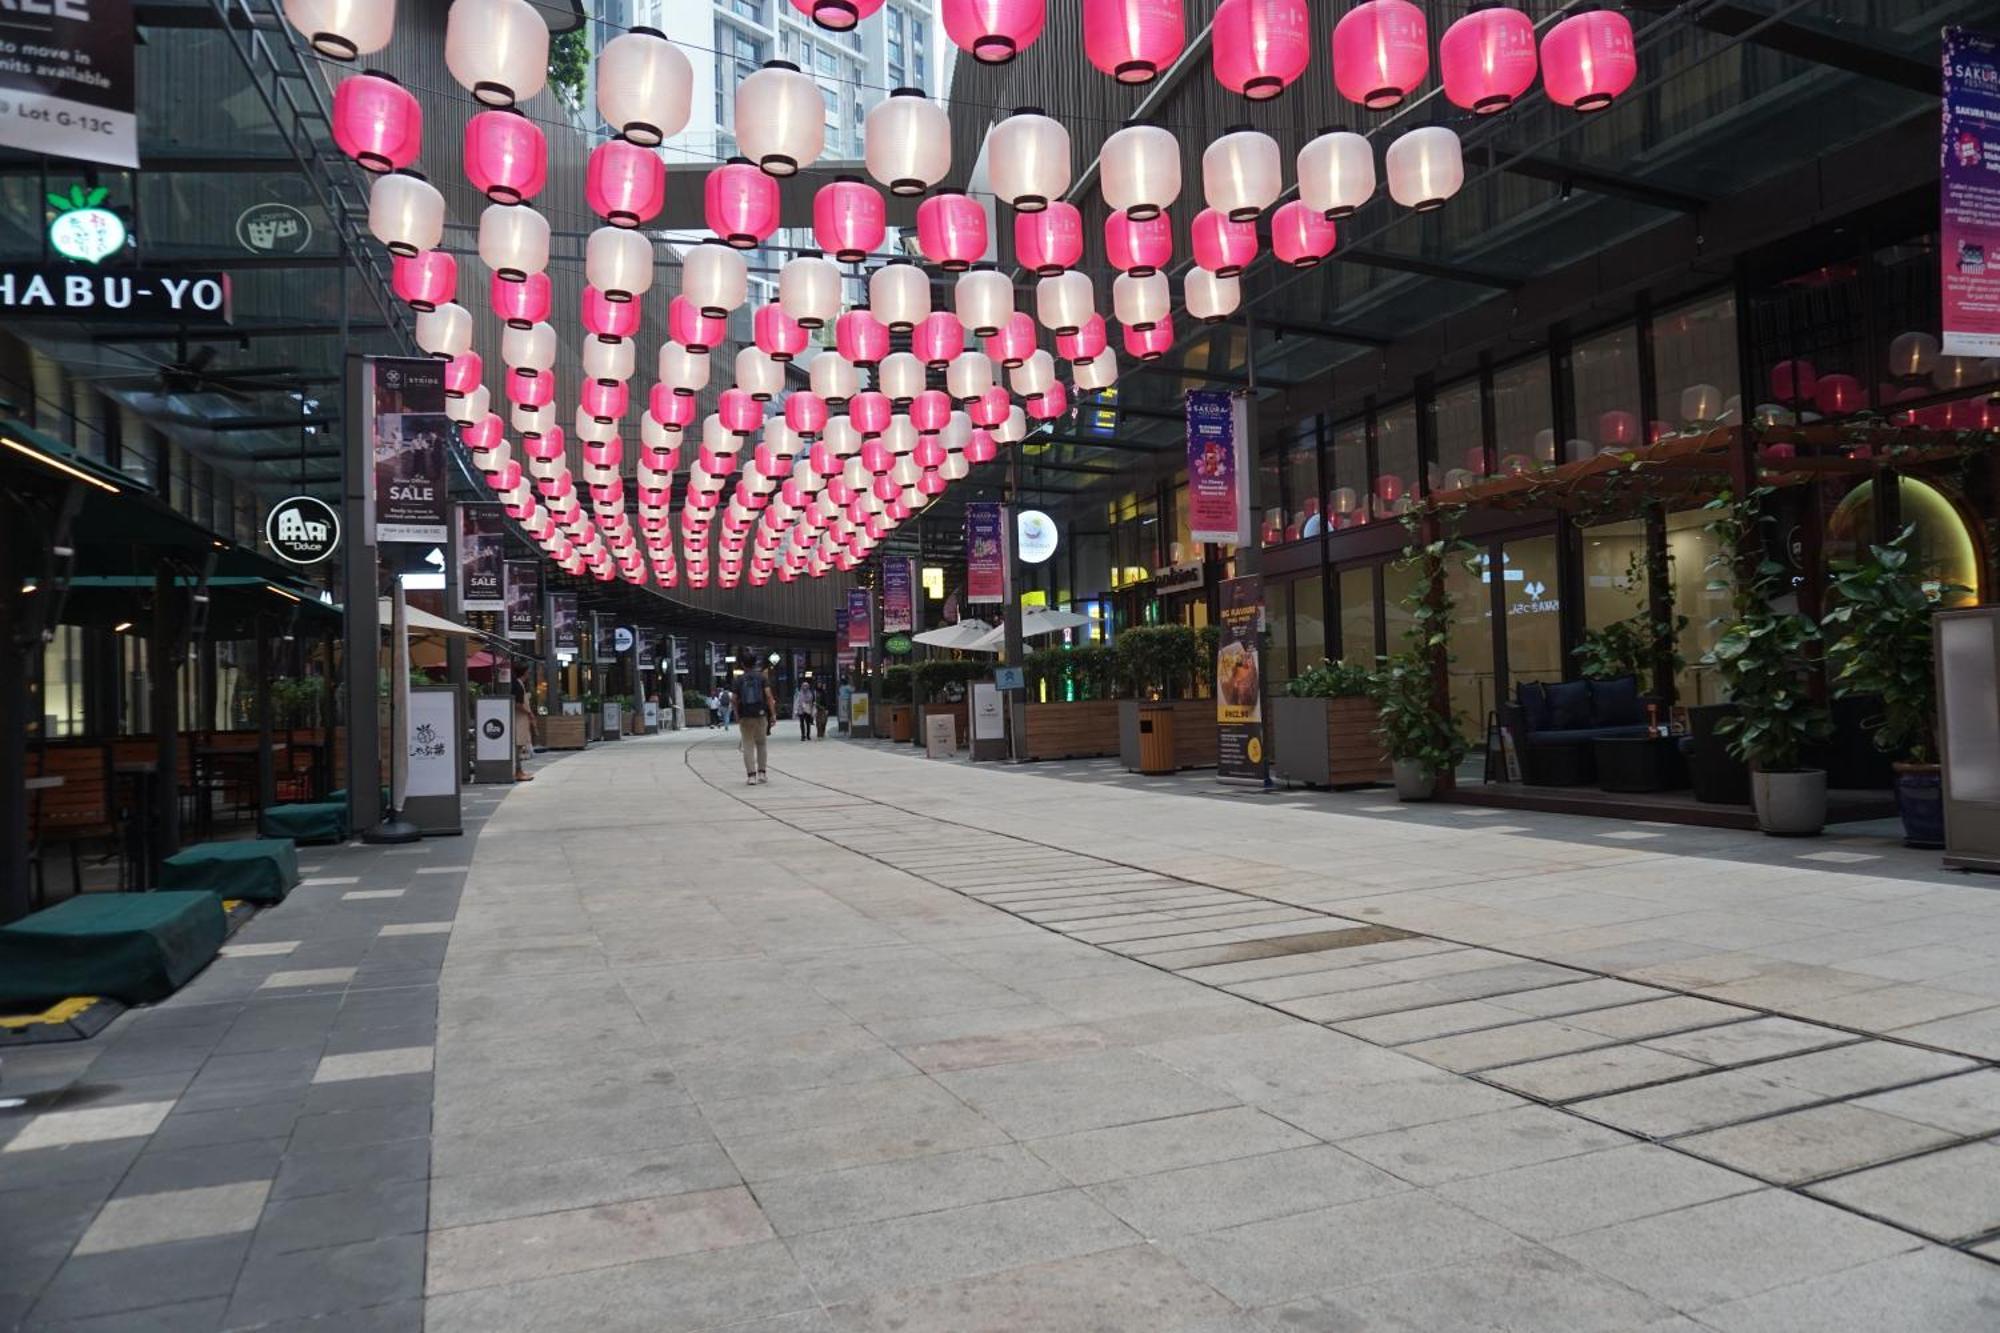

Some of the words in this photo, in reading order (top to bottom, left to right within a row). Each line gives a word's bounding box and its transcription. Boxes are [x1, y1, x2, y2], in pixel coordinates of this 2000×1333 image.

[22, 44, 70, 60] move
[74, 50, 91, 65] in
[36, 64, 111, 88] available
[18, 103, 50, 122] Lot
[56, 111, 114, 135] G-13C
[390, 486, 434, 501] SALE
[470, 578, 497, 586] SALE
